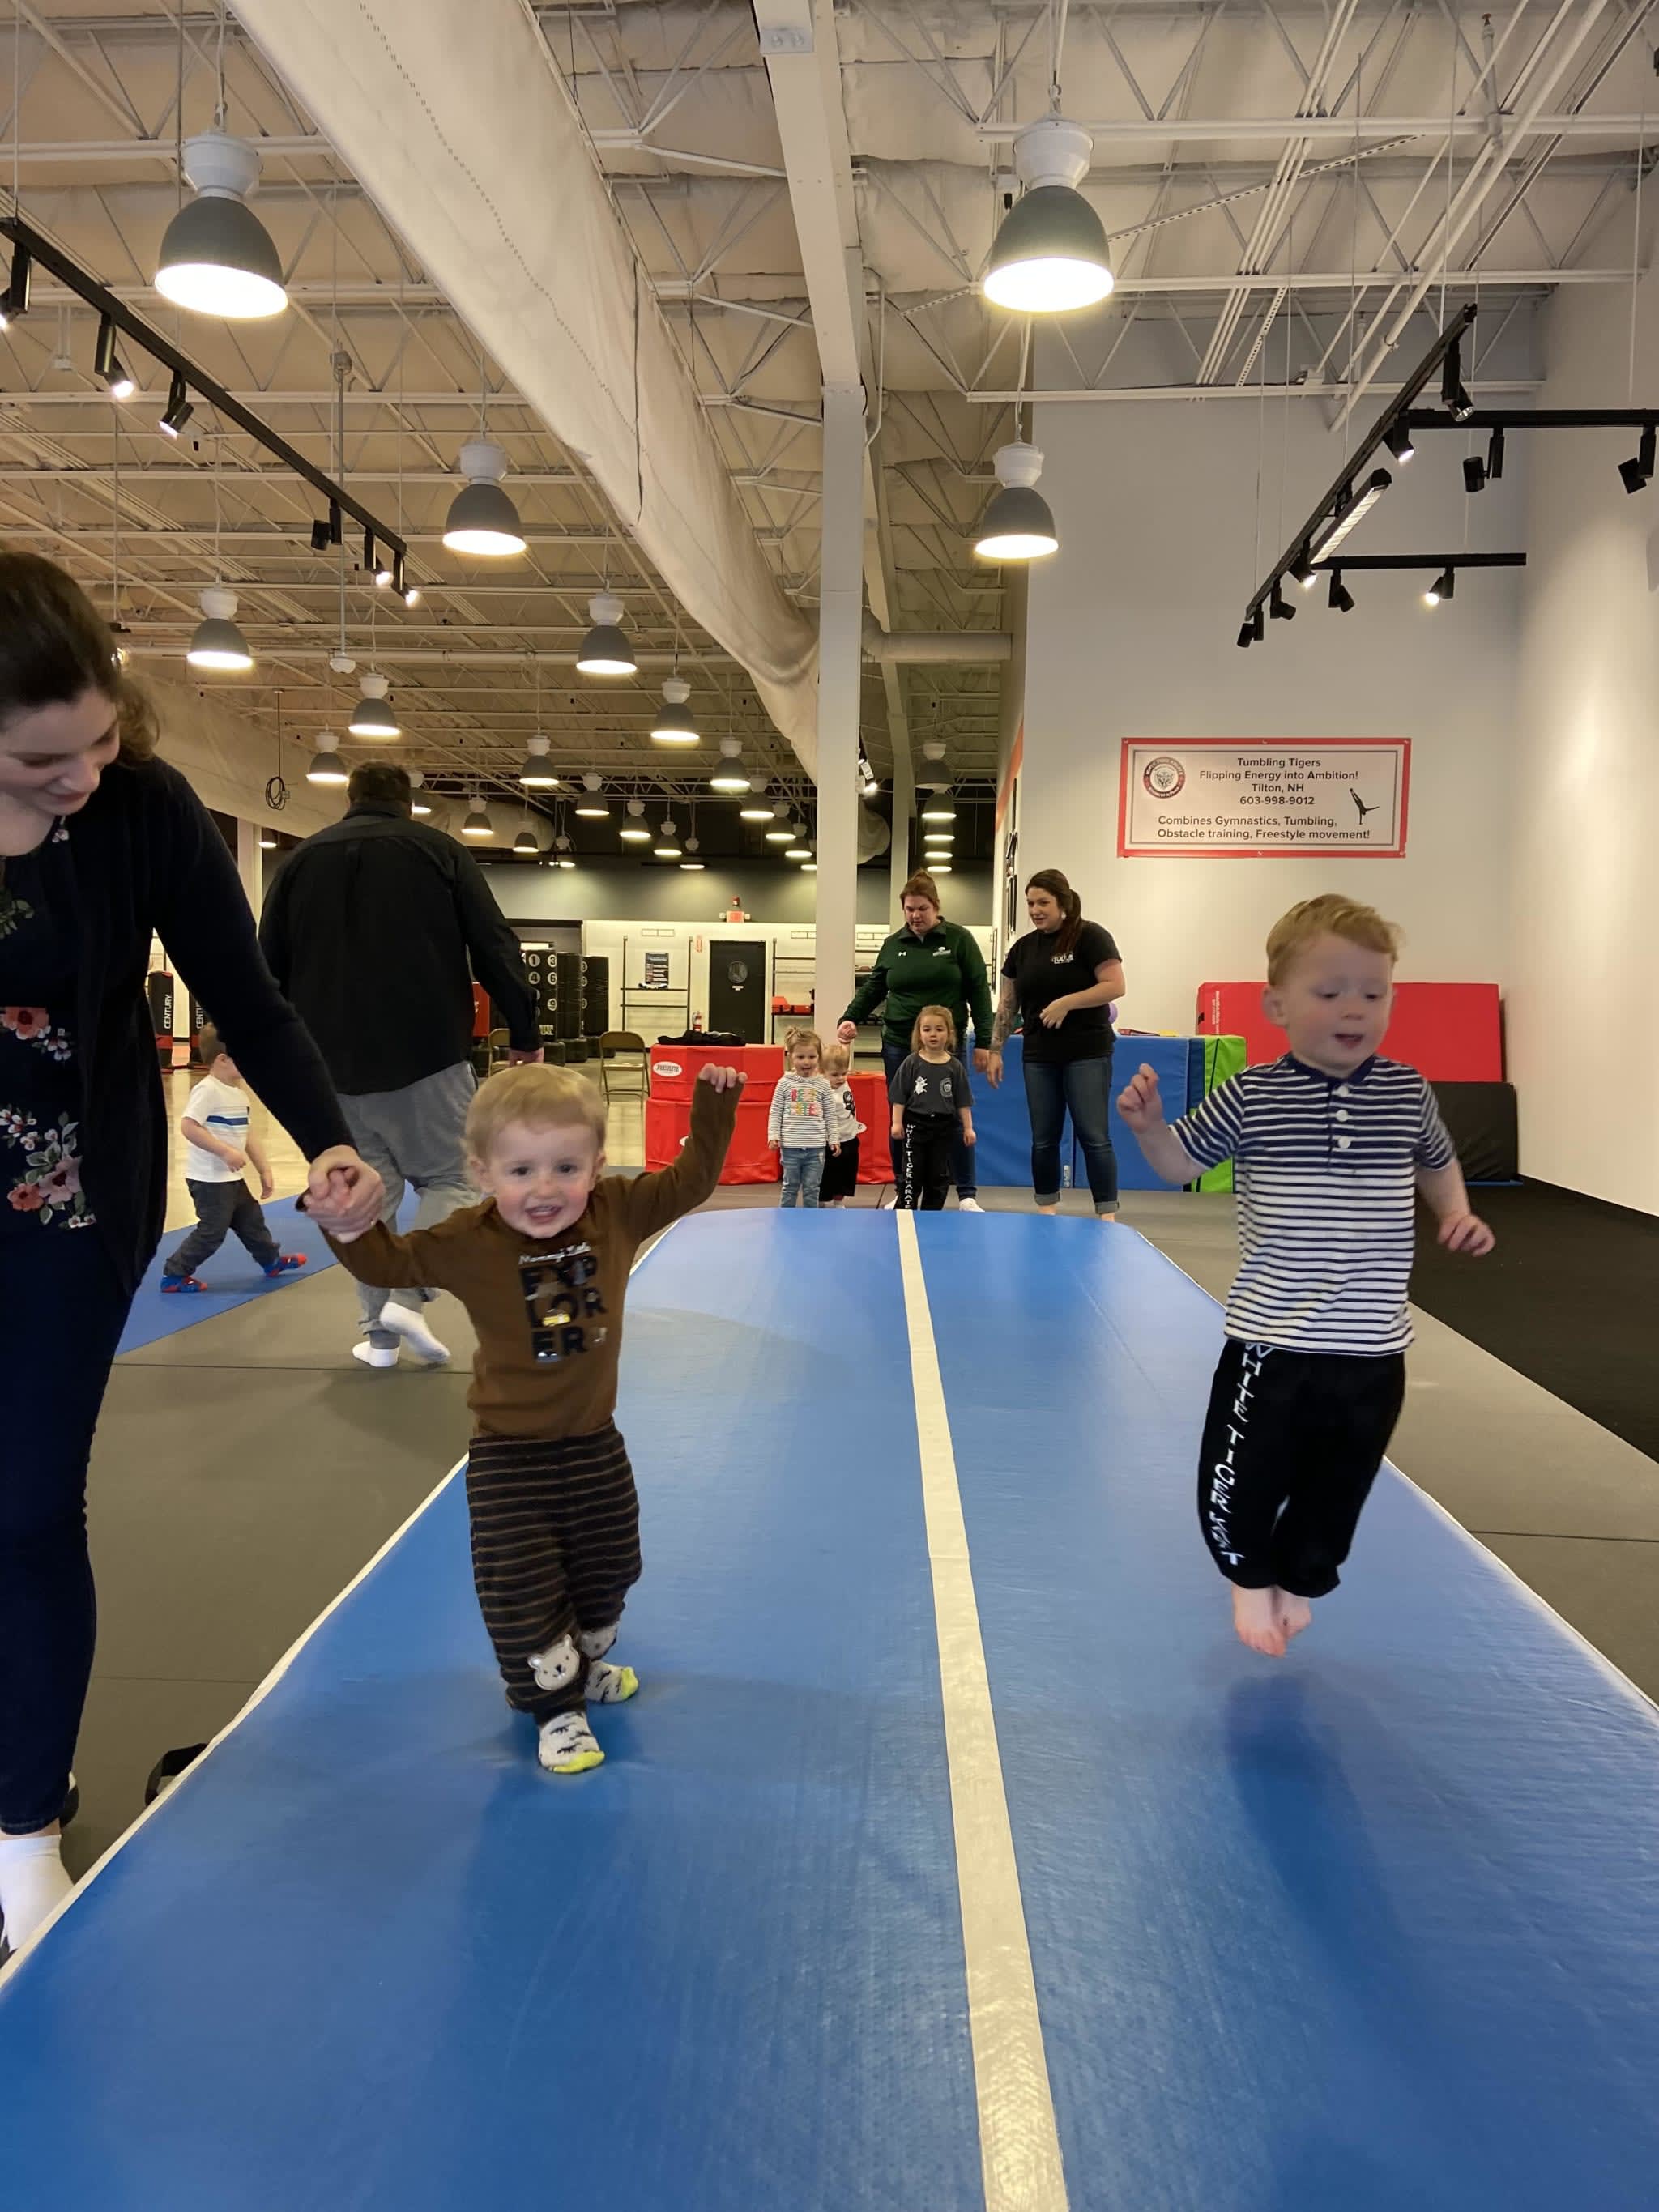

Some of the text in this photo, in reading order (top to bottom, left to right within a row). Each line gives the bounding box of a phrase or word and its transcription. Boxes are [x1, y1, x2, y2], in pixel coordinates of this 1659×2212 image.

[1237, 758, 1321, 768] Tumbling Tigers
[1200, 770, 1358, 781] Flipping Energy into Ambition!
[1252, 784, 1304, 793] Tilton, NH
[1239, 796, 1315, 805] 603-998-9012
[1158, 816, 1337, 827] Combines Gymnastics, Tumbling,
[1158, 829, 1371, 840] Obstacle training, Freestyle movement!
[906, 1123, 916, 1149] WHITE
[906, 1151, 914, 1178] TIGER
[1210, 1424, 1245, 1514] TIGER
